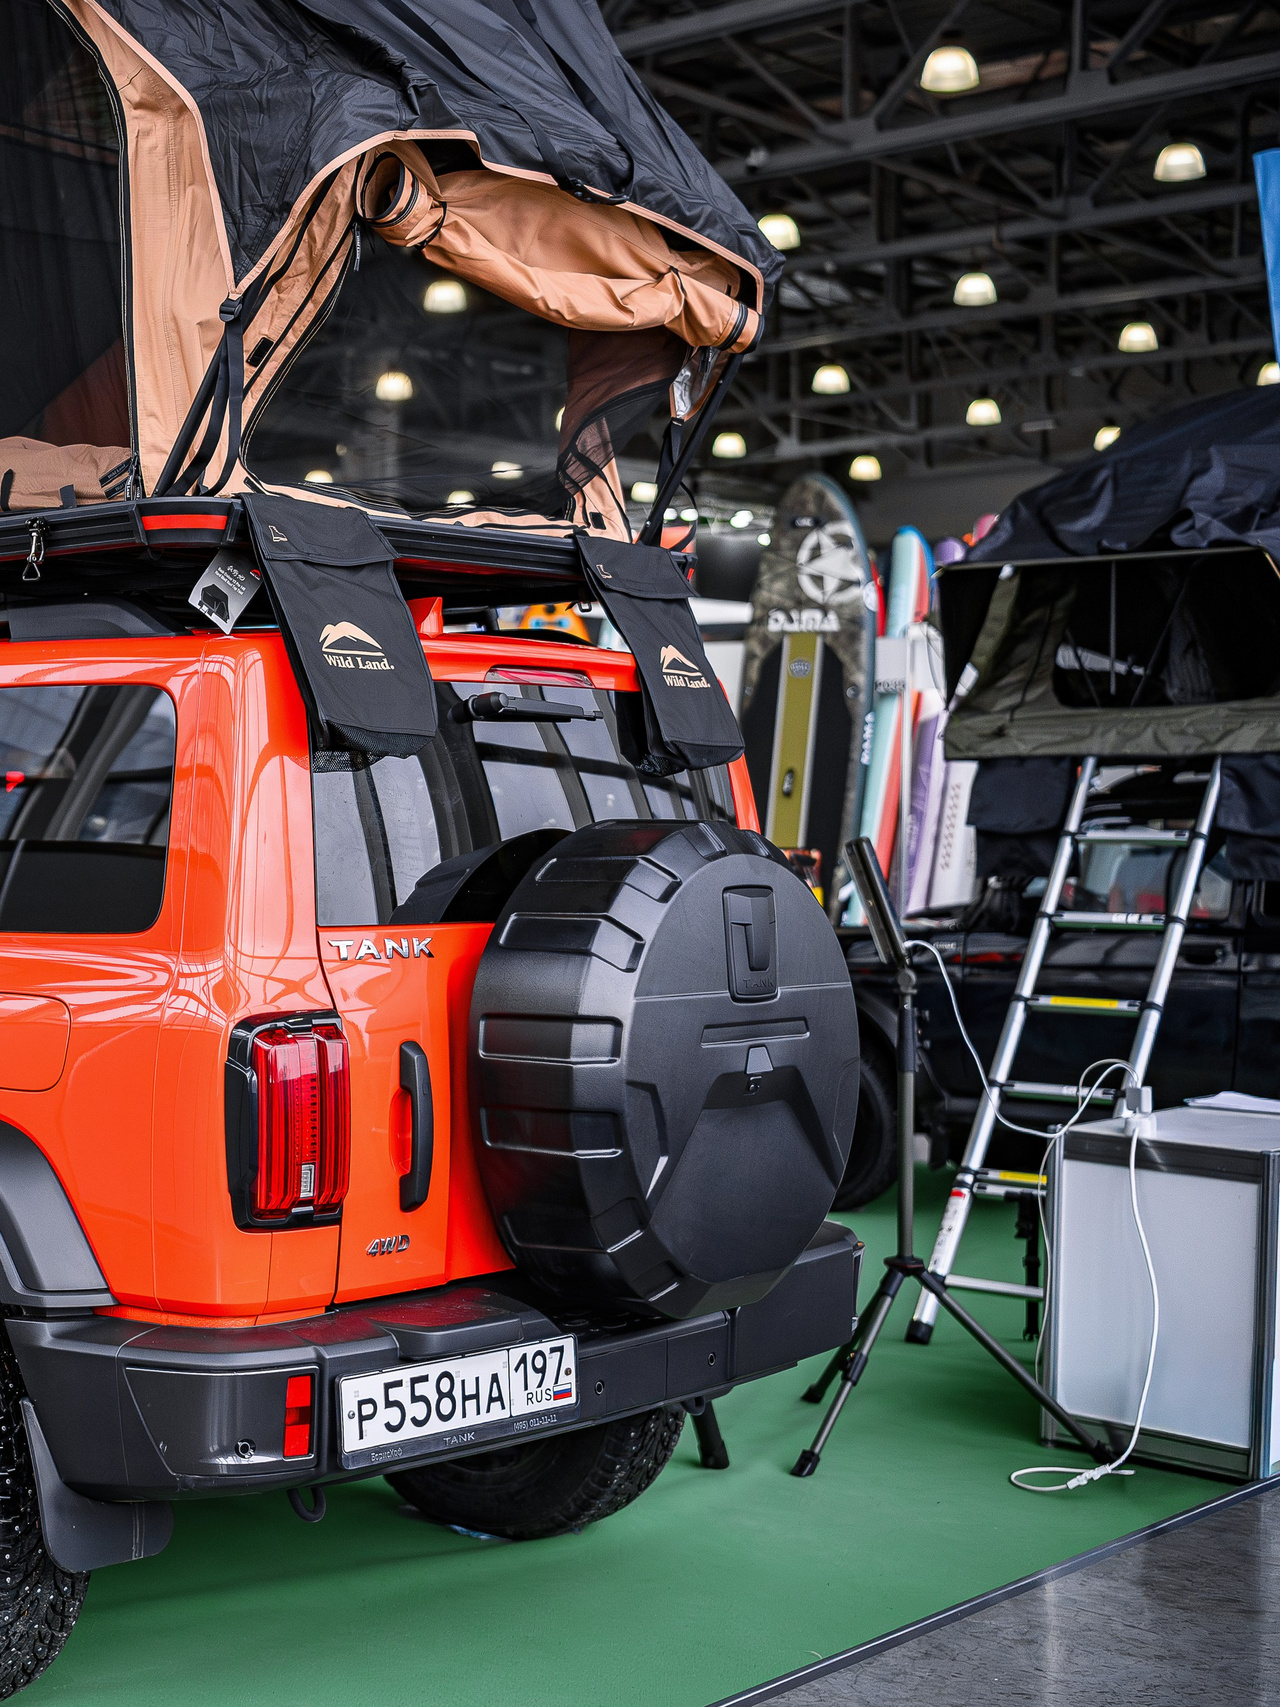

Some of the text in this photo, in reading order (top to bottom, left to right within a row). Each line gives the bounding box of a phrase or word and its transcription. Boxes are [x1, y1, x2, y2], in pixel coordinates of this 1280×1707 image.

[323, 653, 395, 670] Wild Land.
[663, 674, 711, 688] Wild Land.
[328, 937, 435, 960] TANK
[742, 978, 774, 988] TANK
[367, 1234, 410, 1257] 4WD
[514, 1345, 565, 1391] 197
[526, 1388, 552, 1406] RUS
[443, 1431, 475, 1446] TANK
